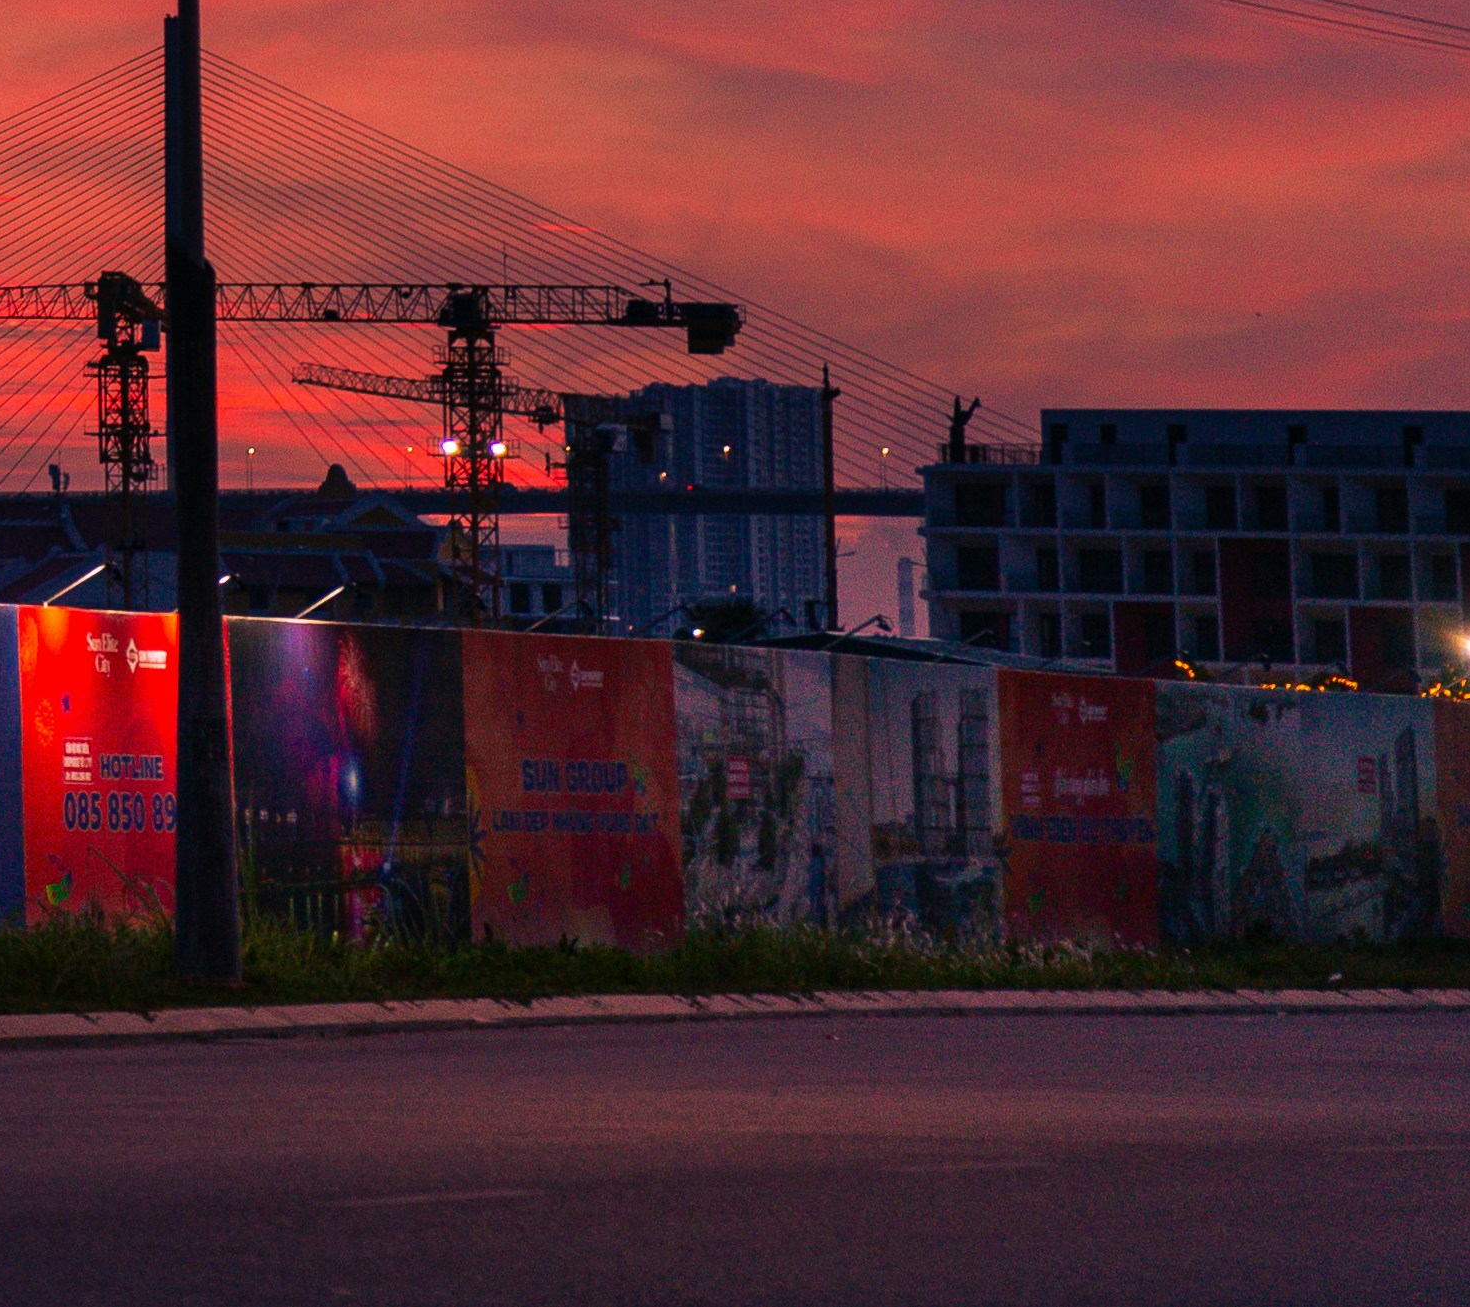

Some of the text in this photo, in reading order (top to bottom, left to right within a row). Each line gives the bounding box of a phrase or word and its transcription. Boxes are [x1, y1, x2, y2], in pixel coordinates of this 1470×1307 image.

[99, 753, 164, 781] HOTLINE
[522, 758, 628, 794] SUN GROUP
[63, 791, 102, 831] 085
[107, 791, 146, 832] 850
